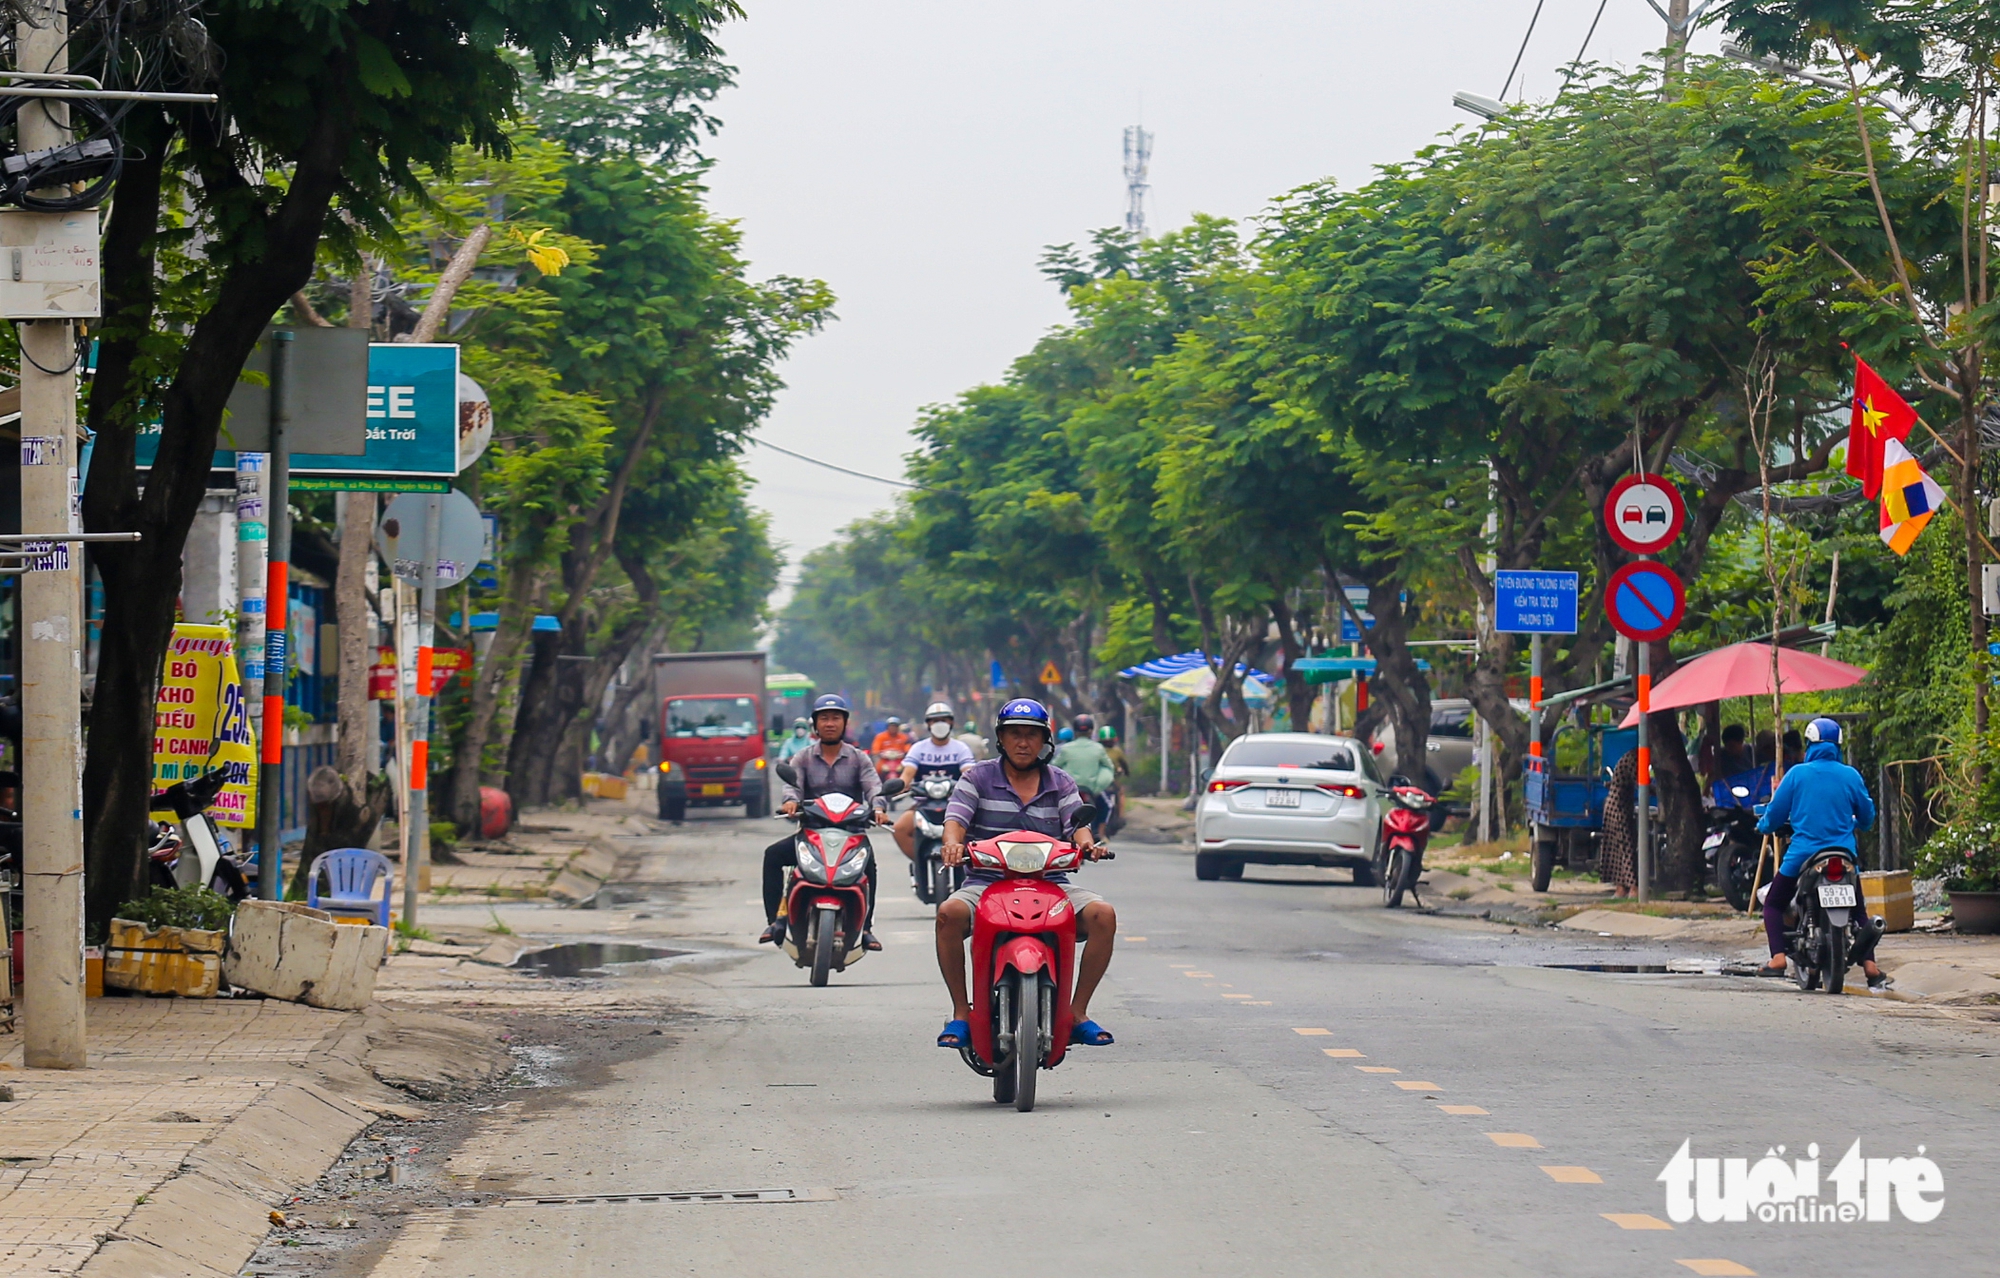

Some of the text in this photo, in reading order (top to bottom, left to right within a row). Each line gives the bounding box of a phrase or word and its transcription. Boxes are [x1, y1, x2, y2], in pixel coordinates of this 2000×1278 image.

[388, 429, 416, 441] Trời
[1497, 573, 1515, 589] TUYẾN
[1515, 574, 1535, 589] ĐƯỜNG
[1535, 574, 1558, 590] THƯỜNG
[1514, 591, 1559, 610] KIỂM TRA TỐC ĐỘ
[1518, 611, 1555, 628] PHƯƠNG TIỆN
[171, 659, 198, 679] BÒ
[169, 739, 209, 755] CANH
[920, 752, 959, 763] TOMMY
[161, 761, 179, 780] MÌ
[1822, 896, 1854, 906] 068.19
